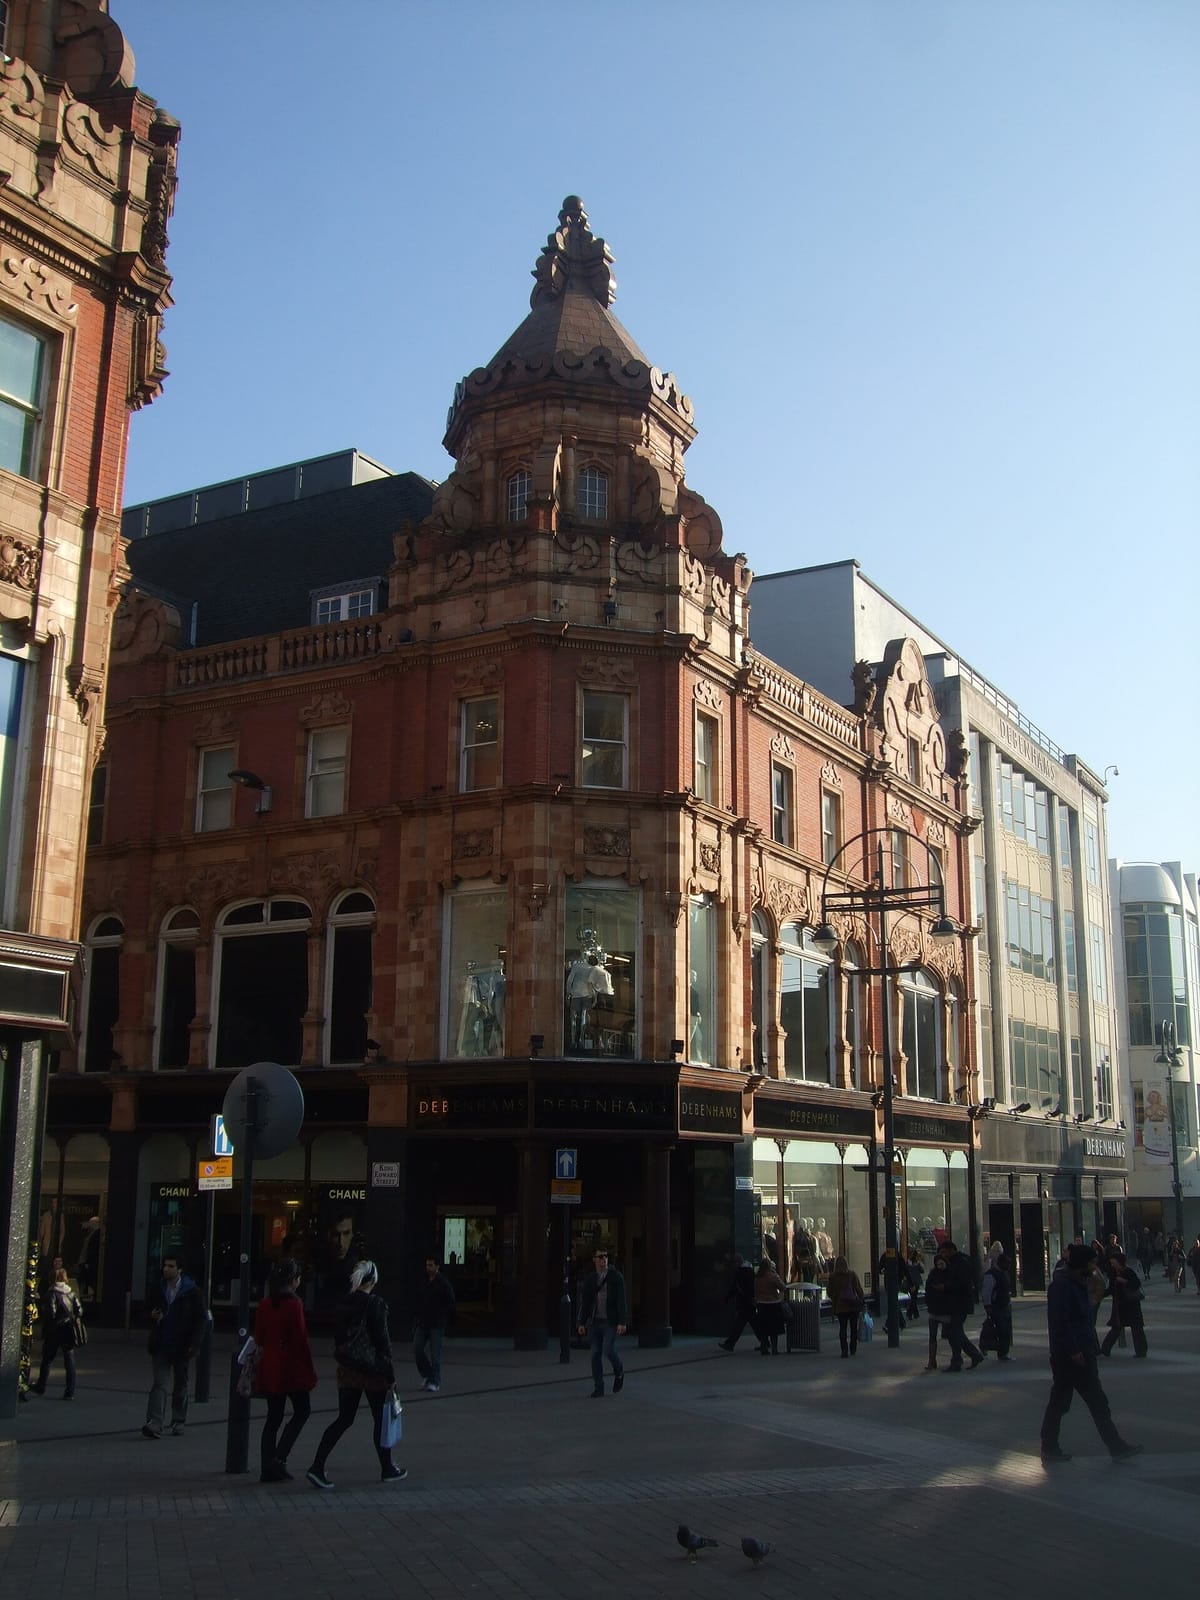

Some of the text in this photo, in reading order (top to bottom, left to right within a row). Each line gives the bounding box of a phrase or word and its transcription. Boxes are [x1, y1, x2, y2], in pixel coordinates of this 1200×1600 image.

[1000, 718, 1055, 781] DEBENHAMS
[419, 1098, 529, 1114] DEBENHAMS
[682, 1102, 737, 1119] DEBENHAMS
[790, 1109, 840, 1126] DEBENHAMS
[1086, 1138, 1126, 1158] DEBENHAMS
